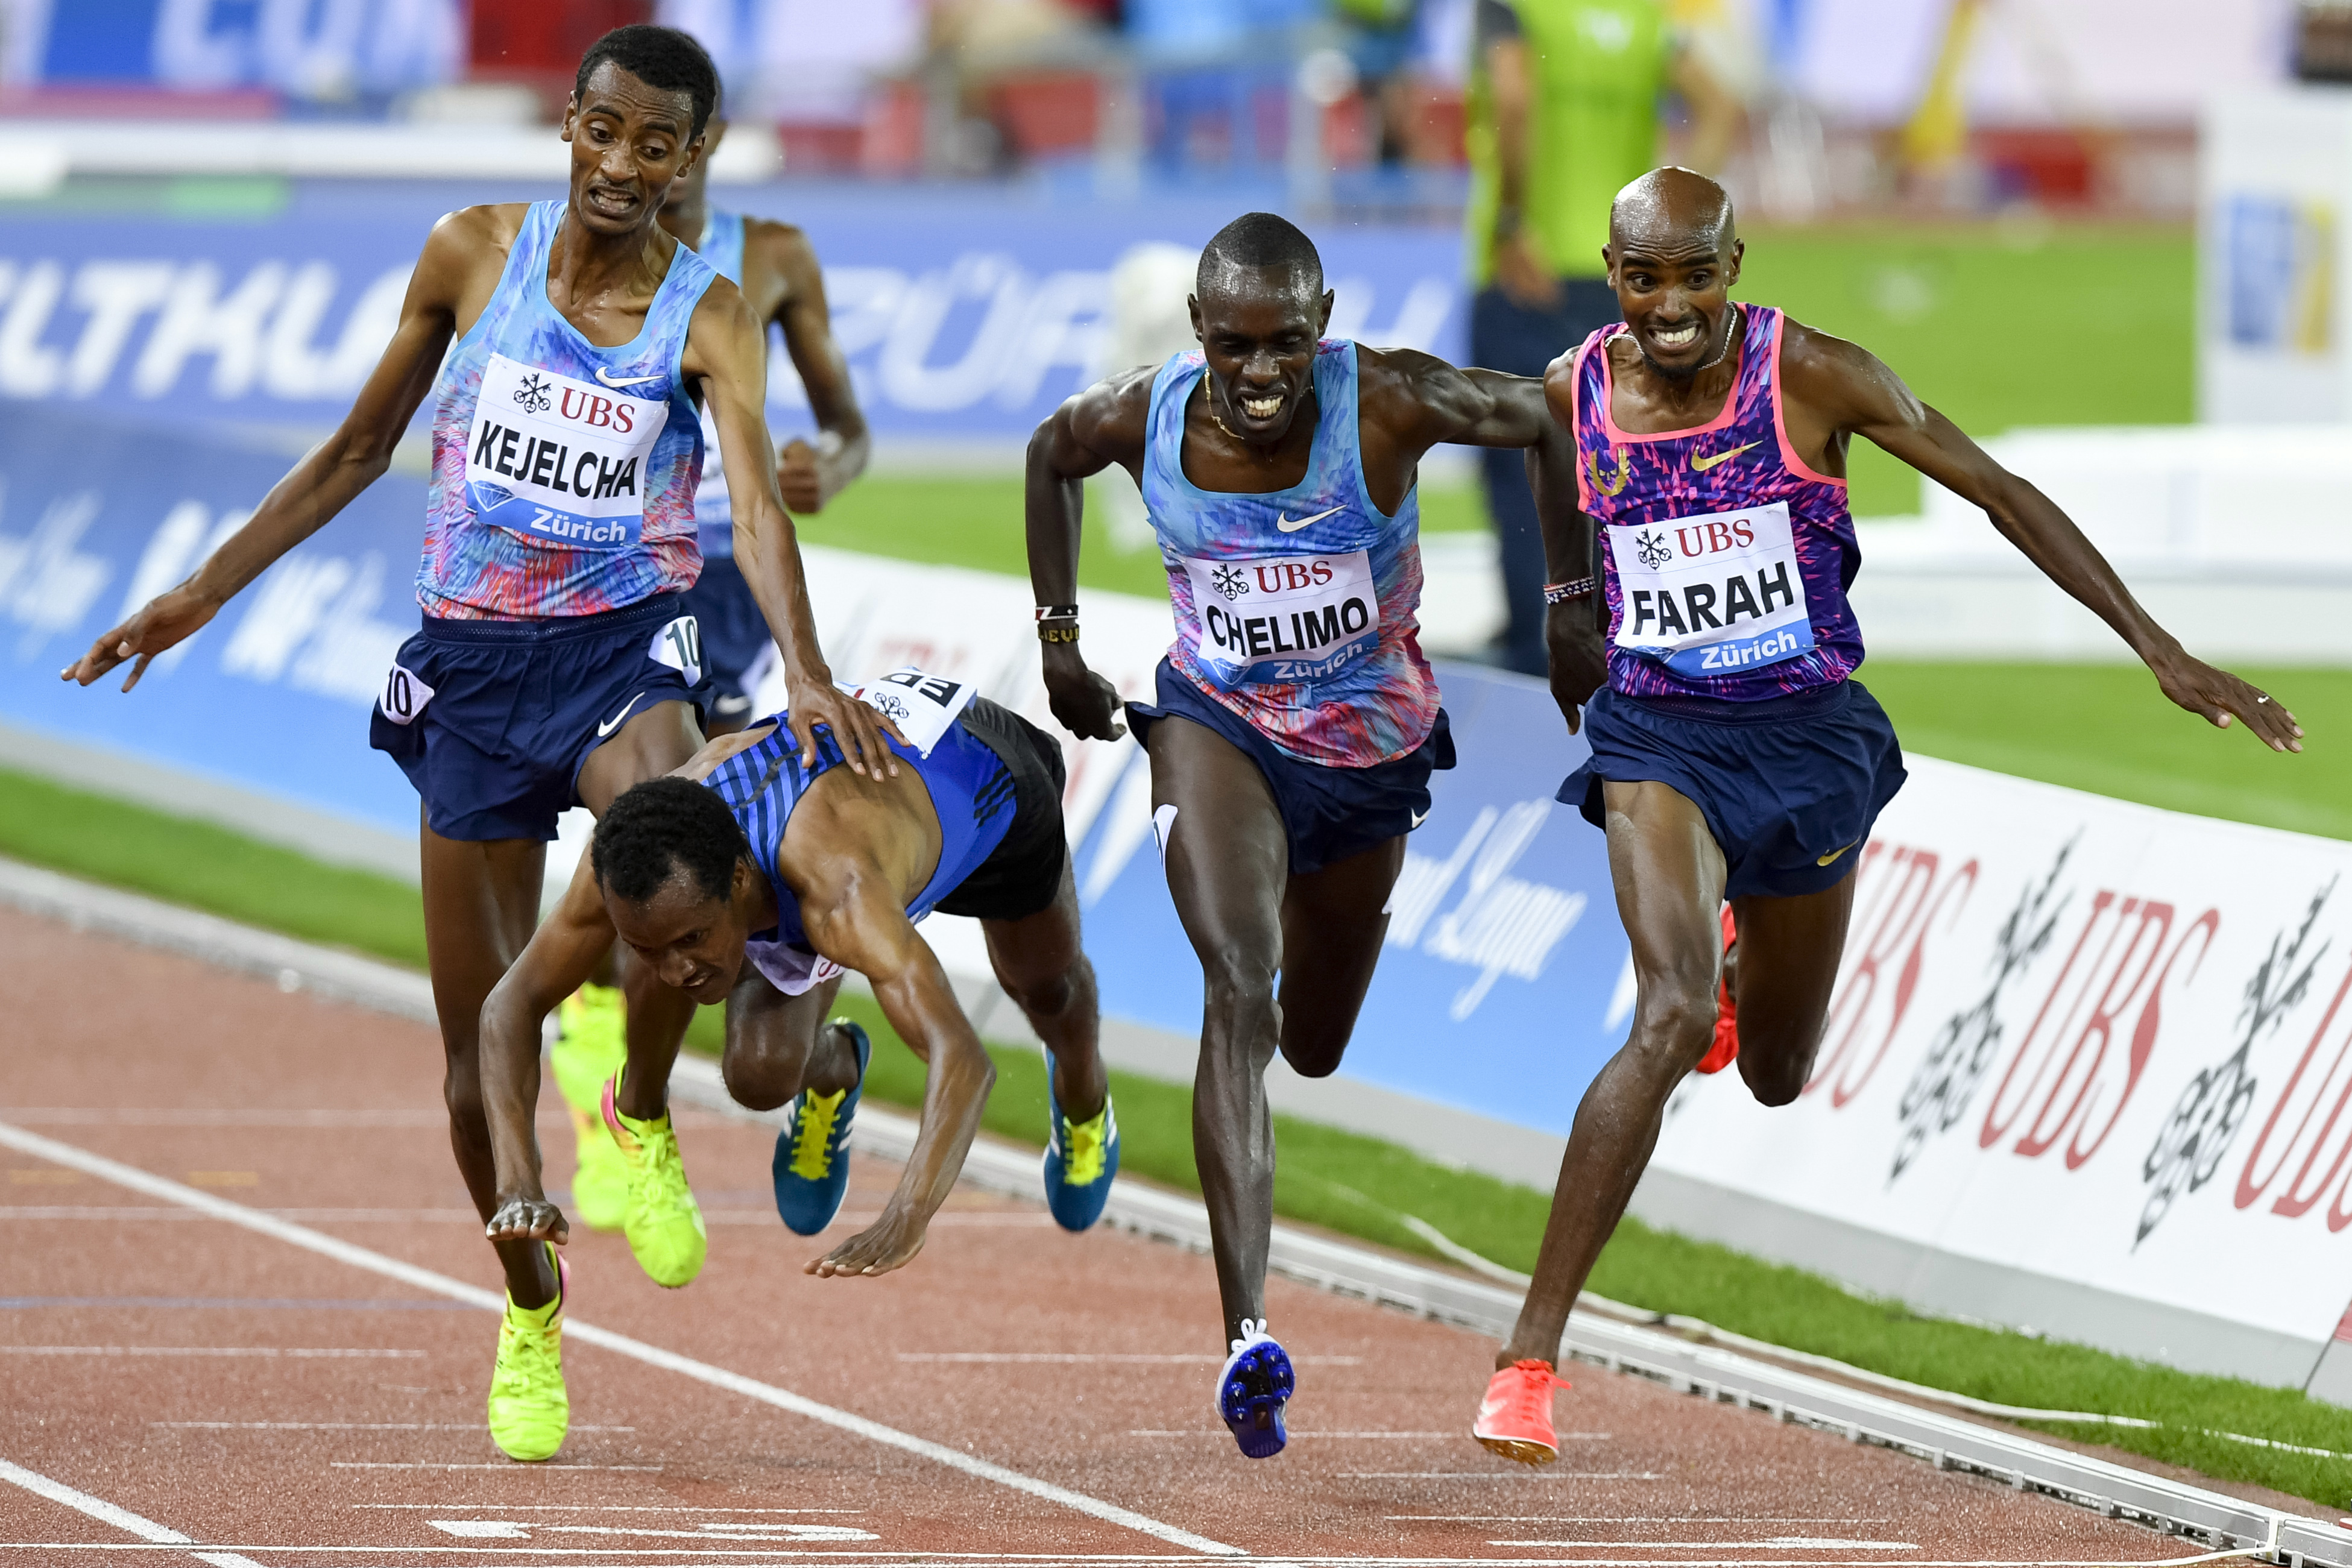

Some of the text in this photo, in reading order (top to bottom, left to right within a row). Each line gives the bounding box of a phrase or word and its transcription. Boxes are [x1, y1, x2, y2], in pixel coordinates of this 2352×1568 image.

[561, 386, 635, 433] UBS
[473, 420, 639, 500] KEJELCHA
[530, 507, 626, 542] Zürich
[1674, 518, 1755, 558] UBS
[1252, 560, 1333, 593] UBS
[1632, 561, 1795, 637] FARAH
[664, 619, 699, 667] 10
[1206, 597, 1369, 657] CHELIMO
[1699, 631, 1798, 670] Zürich
[1273, 642, 1363, 679] Zürich
[386, 664, 412, 717] 10
[1978, 889, 2221, 1171] UBS
